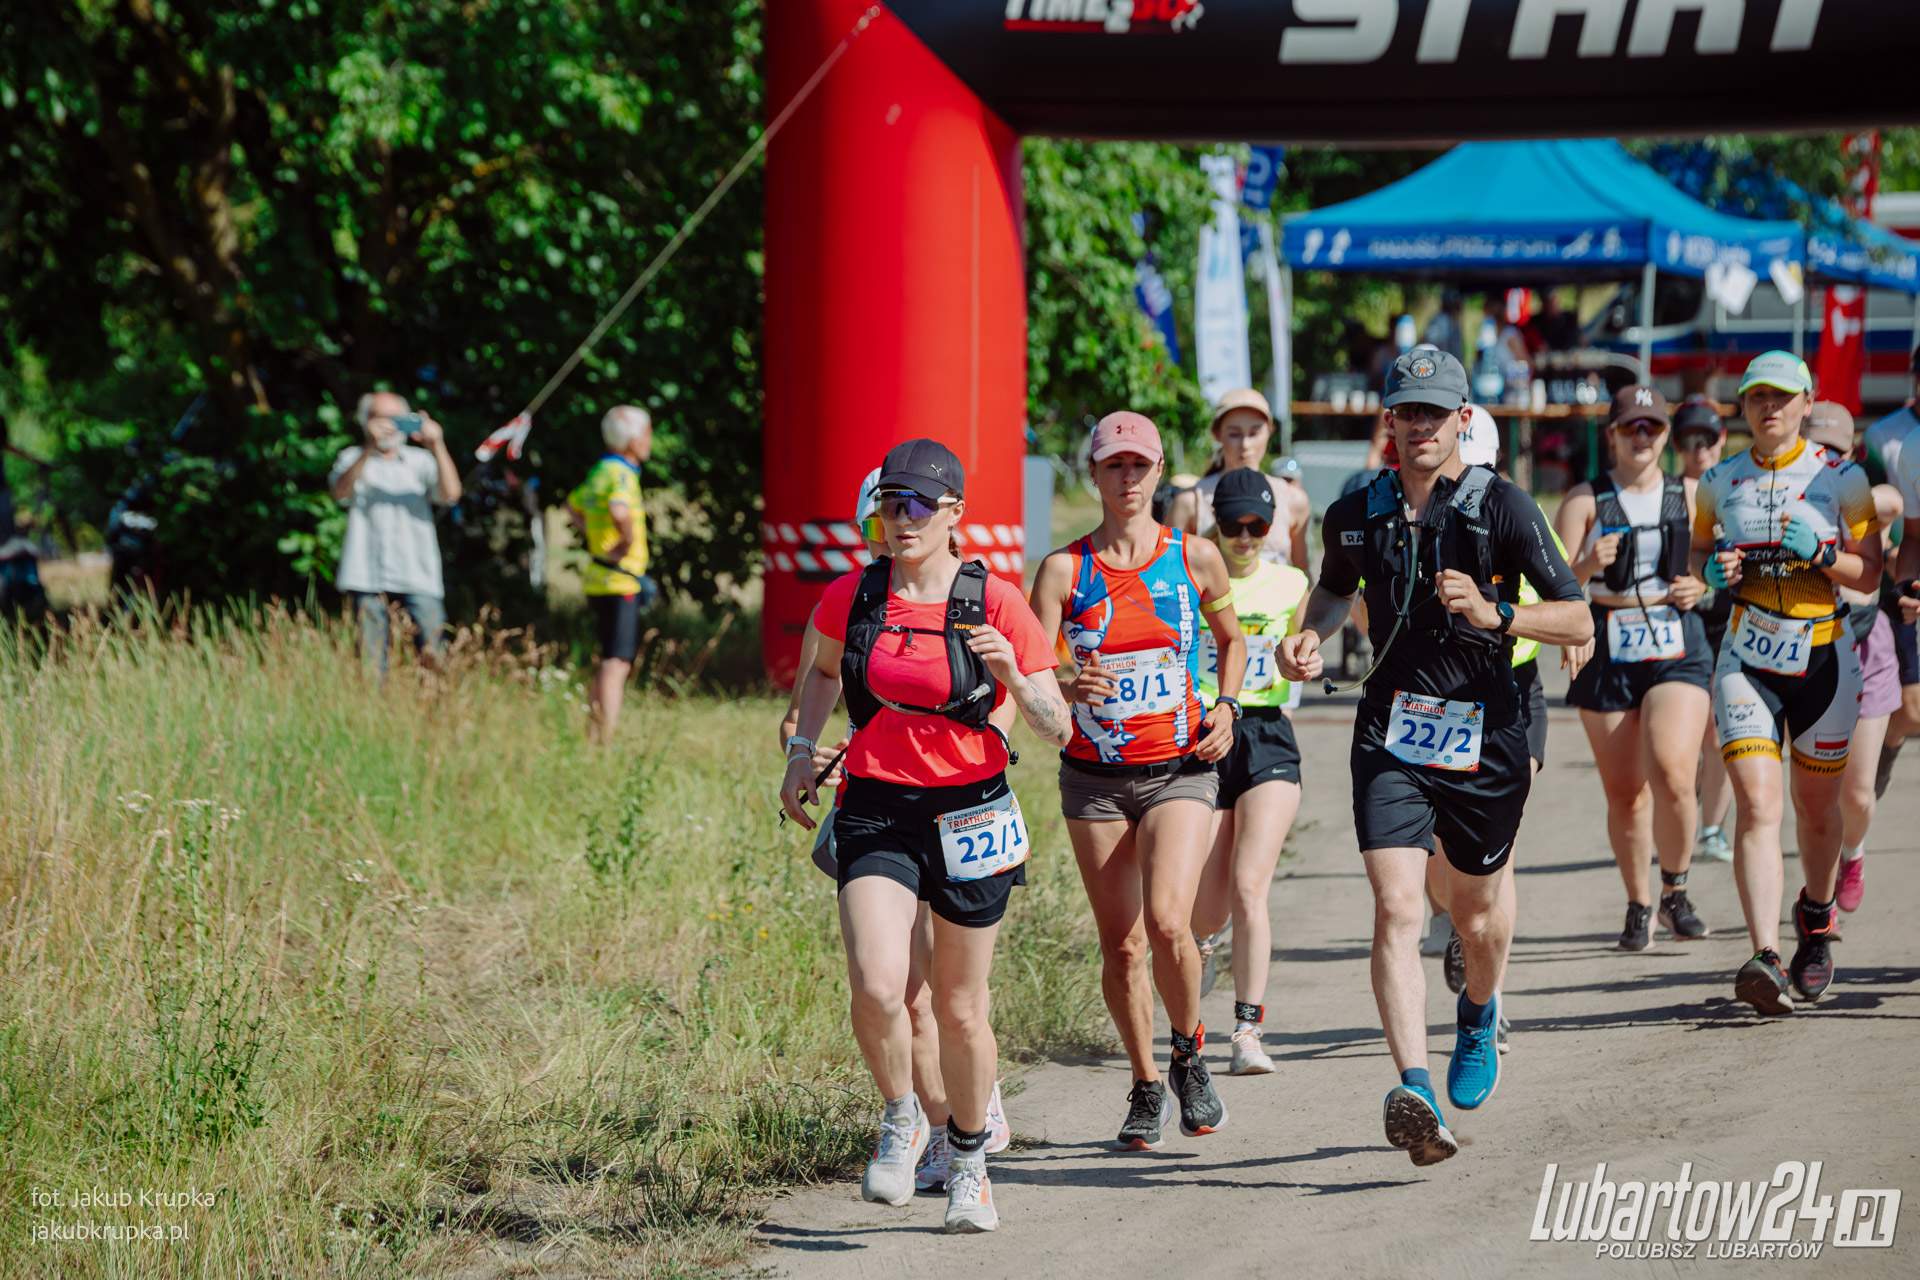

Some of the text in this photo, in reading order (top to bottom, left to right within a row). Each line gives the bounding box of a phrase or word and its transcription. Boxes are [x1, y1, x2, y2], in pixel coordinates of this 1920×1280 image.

[1743, 628, 1800, 661] 20/1
[1207, 652, 1266, 677] 2/1
[1401, 701, 1446, 715] TRIATHLON
[1399, 719, 1472, 753] 22/2
[947, 811, 996, 829] TRIATHLON
[956, 819, 1022, 864] 22/1
